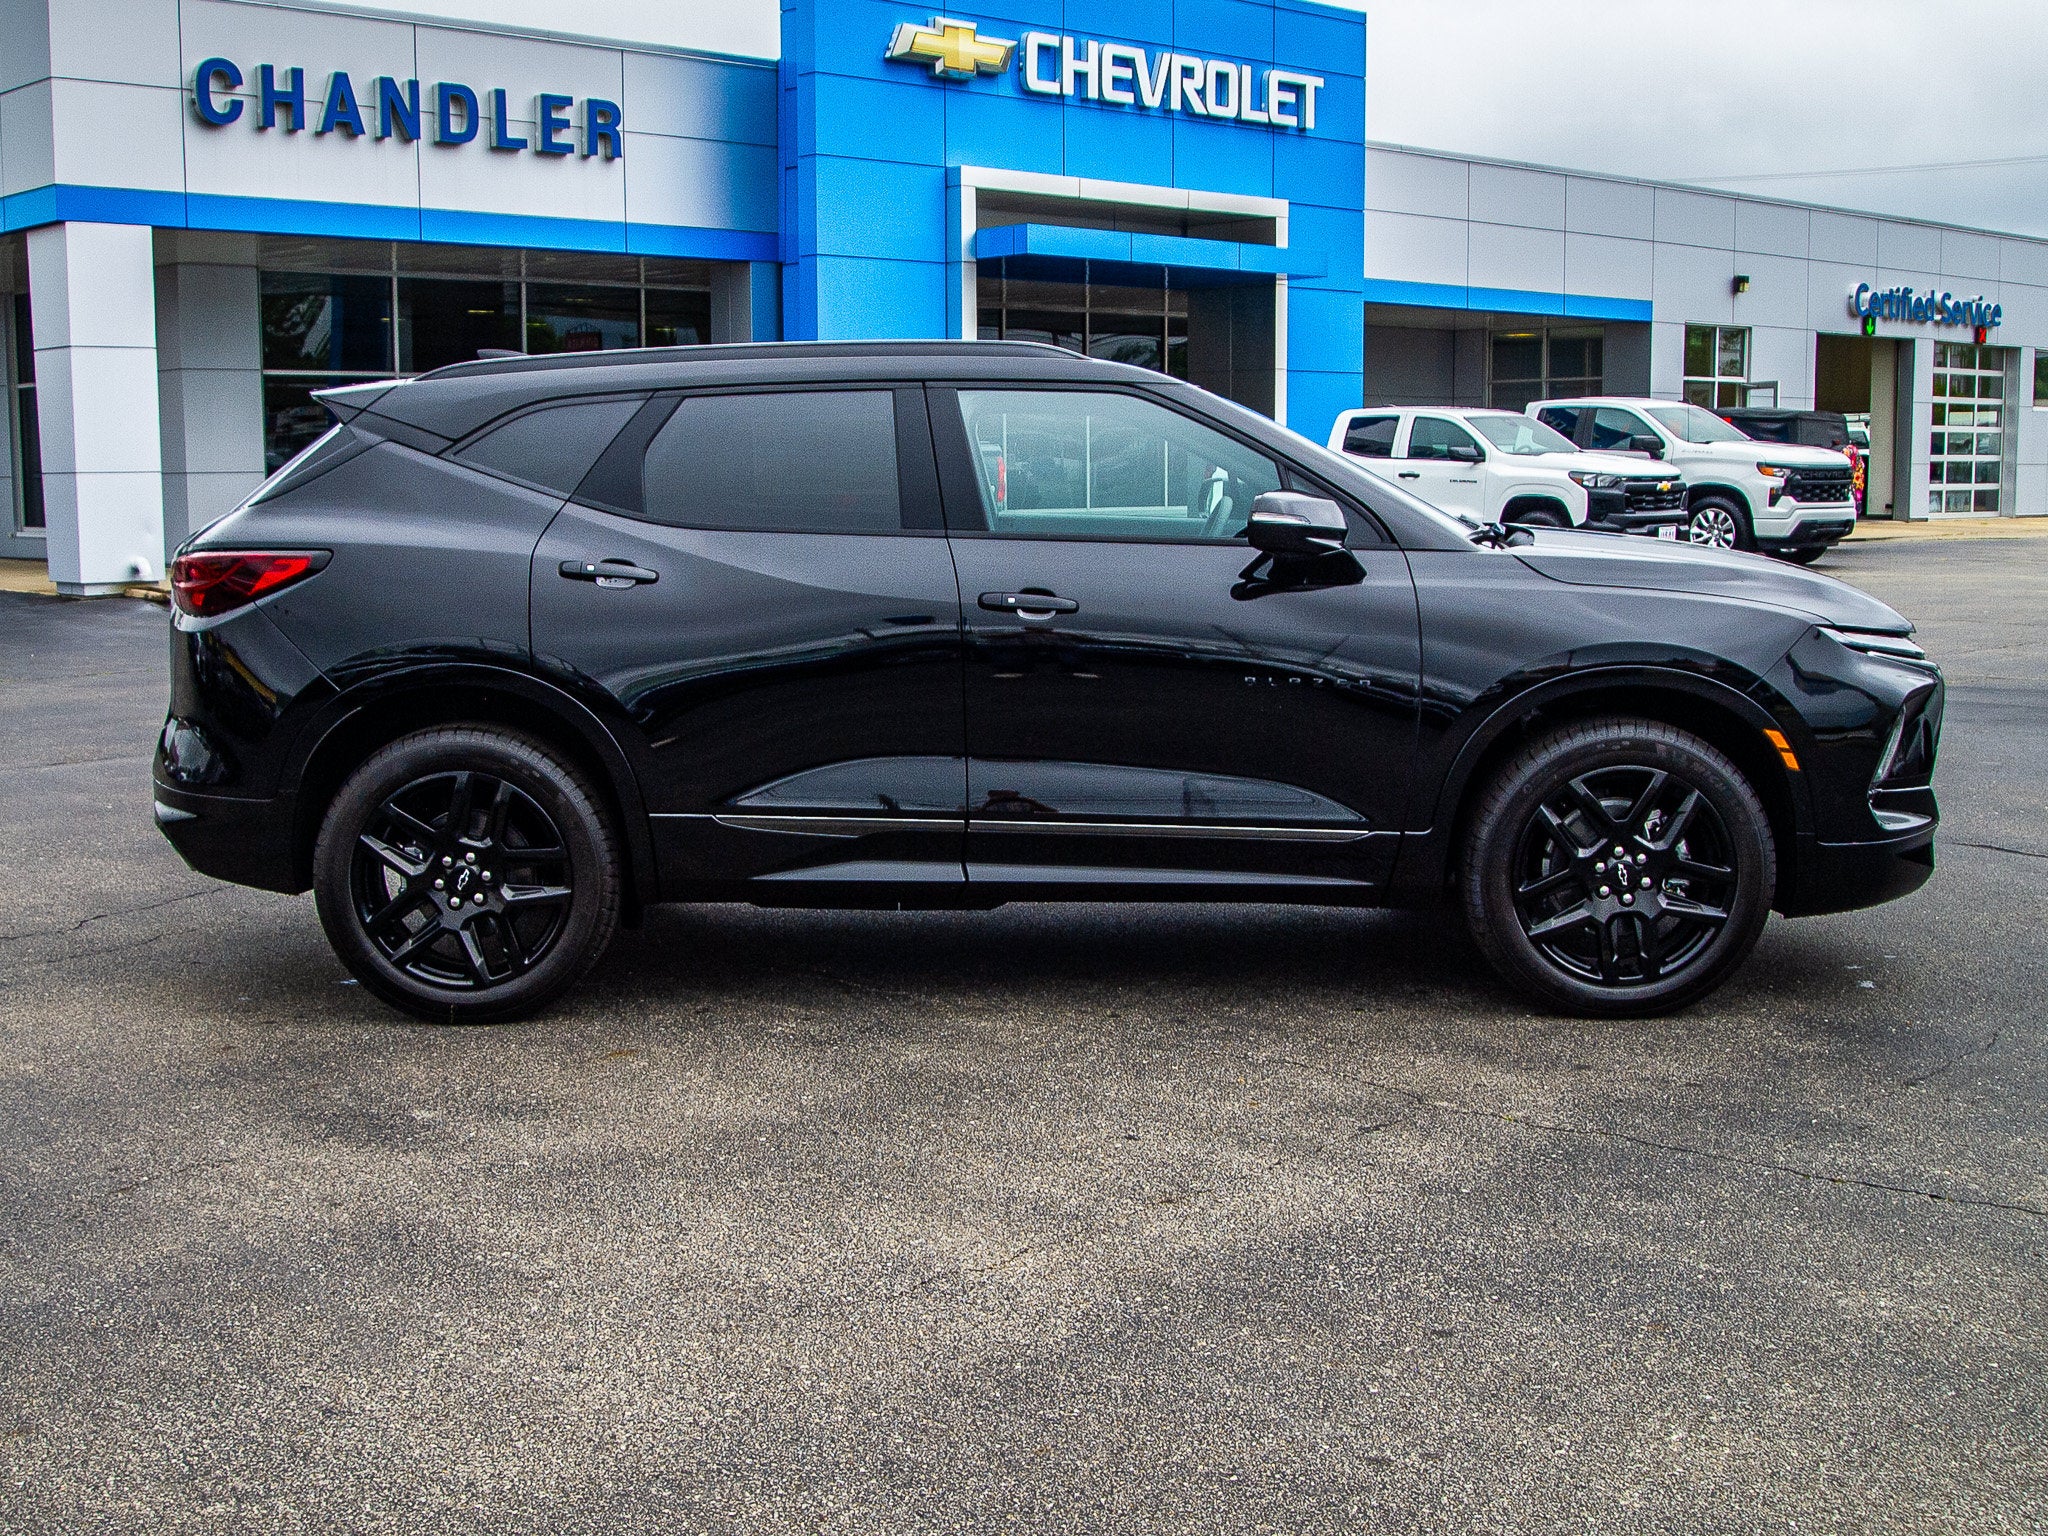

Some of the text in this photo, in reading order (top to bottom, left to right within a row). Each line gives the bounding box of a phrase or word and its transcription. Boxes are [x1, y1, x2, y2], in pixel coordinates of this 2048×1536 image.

[192, 56, 623, 159] CHANDLER
[1022, 31, 1324, 130] CHEVROLET
[1852, 282, 2003, 328] Certified Service
